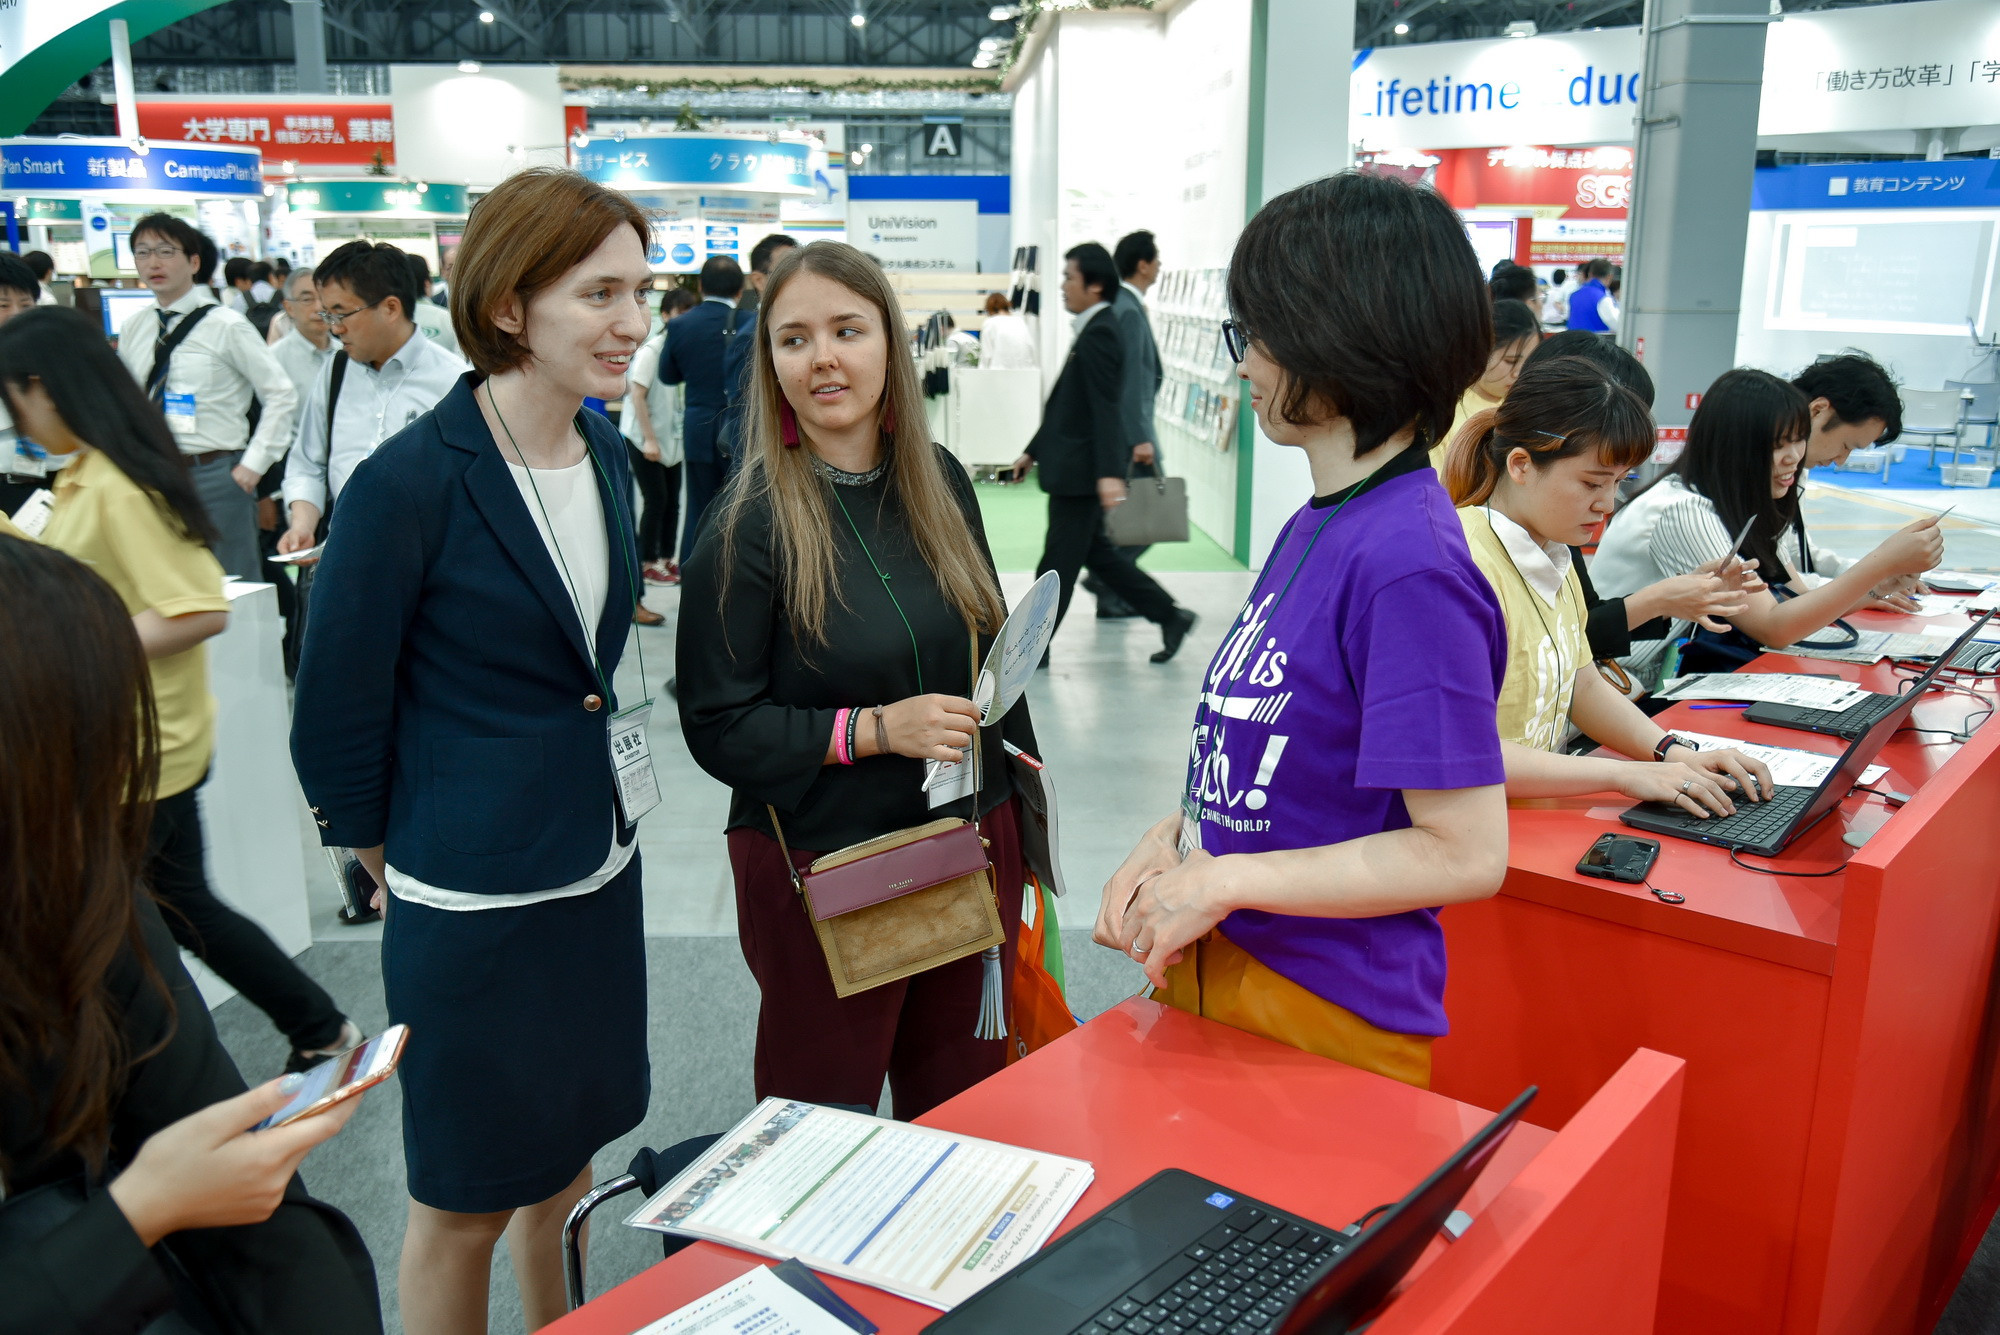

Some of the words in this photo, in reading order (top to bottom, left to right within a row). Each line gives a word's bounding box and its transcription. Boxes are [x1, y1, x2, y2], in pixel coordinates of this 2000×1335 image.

[1358, 76, 1521, 118] ifetime
[183, 117, 271, 142] 大学専門
[928, 125, 957, 155] A
[23, 157, 66, 175] Smart
[87, 157, 148, 178] 新製品
[1853, 176, 1966, 193] 教育コンテンツ
[868, 216, 938, 230] UniVision
[1248, 637, 1288, 688] is
[613, 731, 642, 755] 出展社
